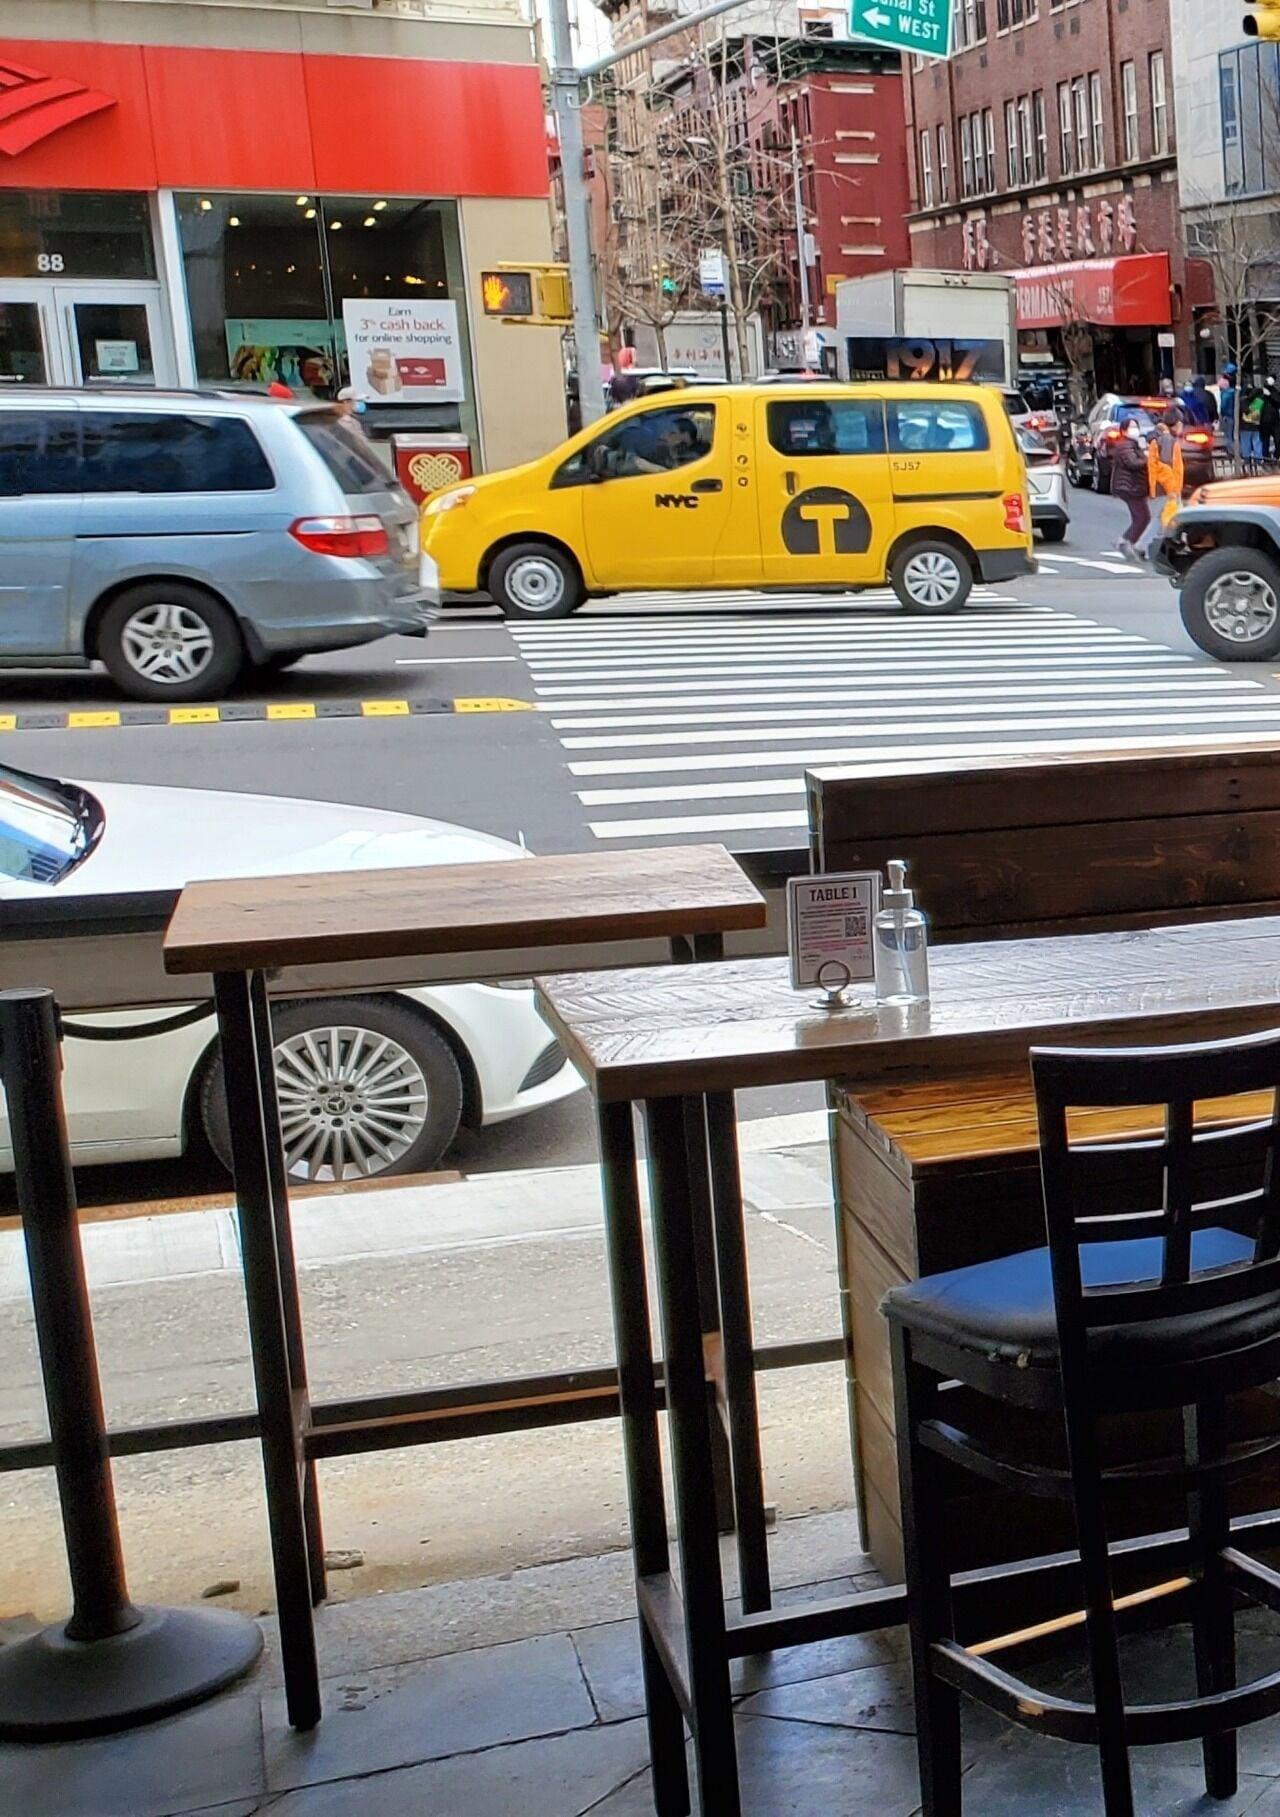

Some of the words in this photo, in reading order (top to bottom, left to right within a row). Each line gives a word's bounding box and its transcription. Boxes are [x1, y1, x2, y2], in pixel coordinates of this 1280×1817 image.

[871, 0, 912, 11] anal
[918, 0, 935, 17] St
[898, 15, 940, 40] WEST
[37, 254, 64, 272] 88
[388, 307, 411, 316] Earn
[380, 318, 410, 330] cash
[414, 318, 445, 330] back
[355, 334, 368, 342] for
[372, 333, 402, 343] online
[406, 333, 452, 345] shopping
[655, 494, 698, 508] NYC
[800, 503, 850, 554] T
[809, 887, 849, 902] TABLE
[852, 887, 857, 899] 1
